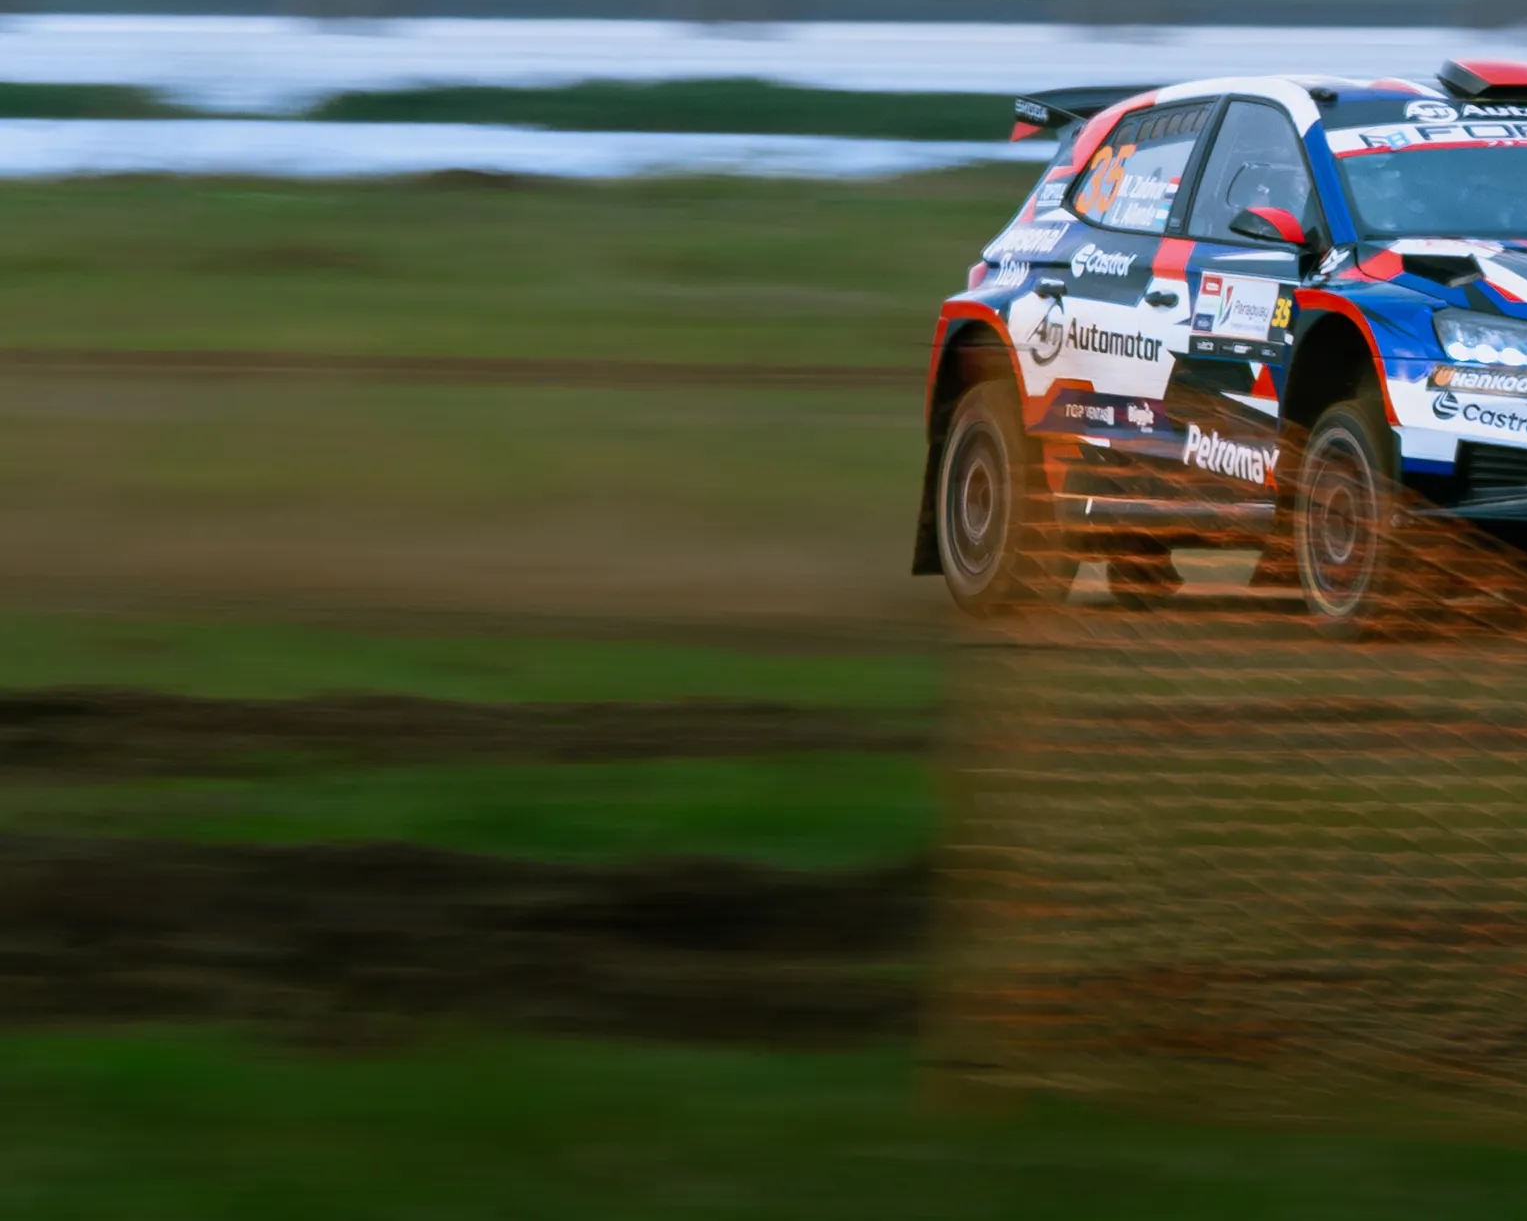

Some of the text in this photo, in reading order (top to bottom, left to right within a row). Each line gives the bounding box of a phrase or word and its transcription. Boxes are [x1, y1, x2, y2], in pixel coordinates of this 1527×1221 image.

[1074, 144, 1137, 215] 35
[1086, 249, 1137, 276] Castrol
[1271, 297, 1292, 328] 35
[1066, 317, 1162, 362] Automotor
